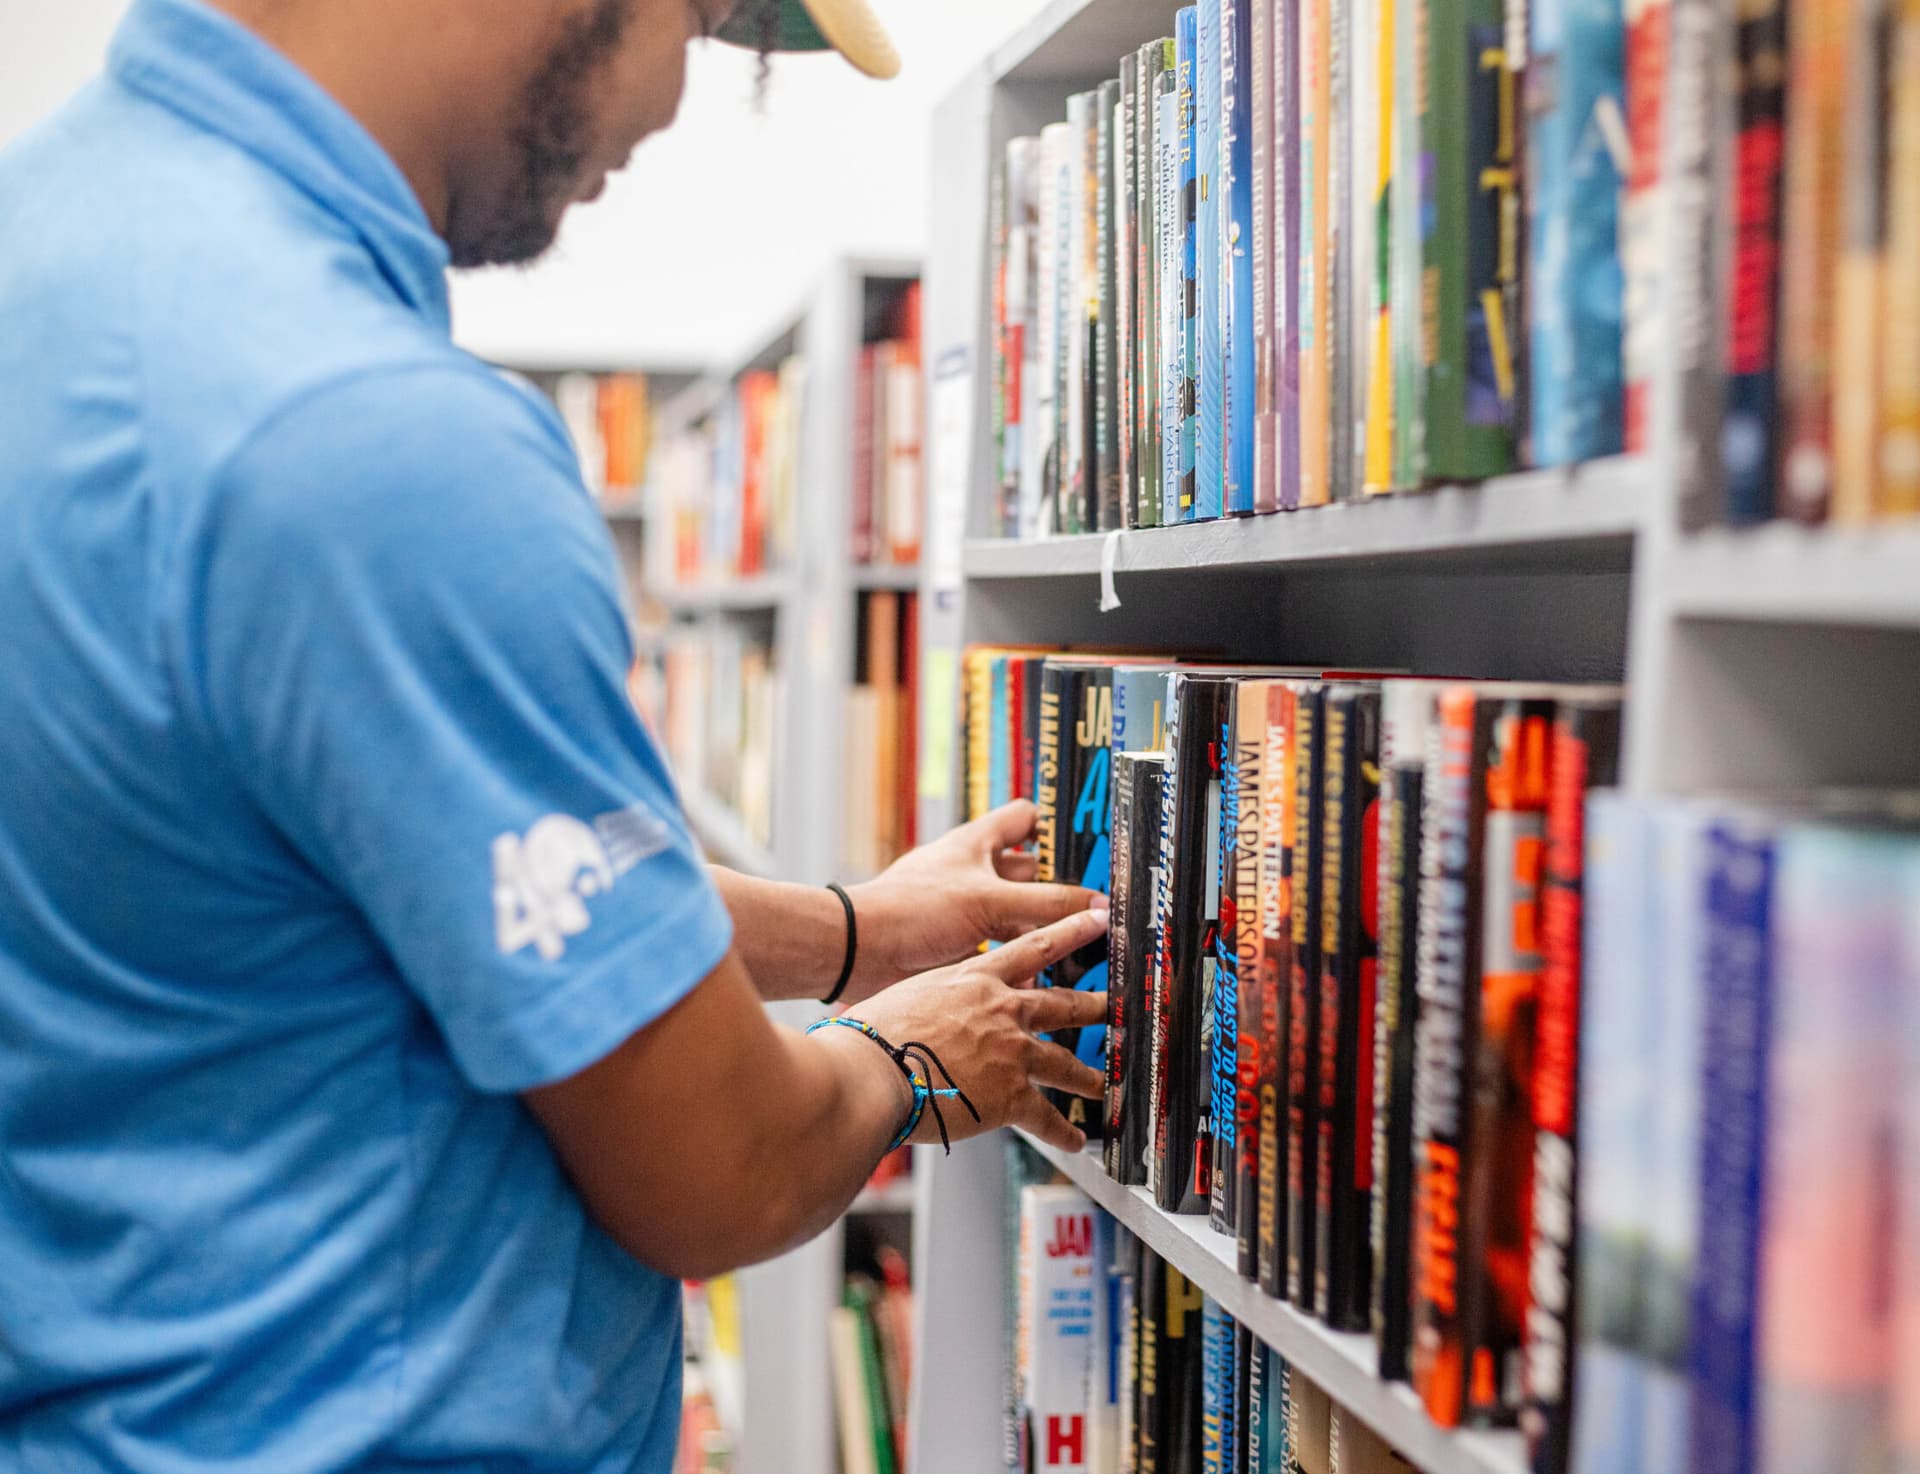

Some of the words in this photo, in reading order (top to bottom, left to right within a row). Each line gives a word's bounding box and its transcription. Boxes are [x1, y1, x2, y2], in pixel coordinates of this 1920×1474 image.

[1177, 60, 1191, 140] Robert
[1166, 363, 1175, 417] KATE
[1165, 425, 1175, 508] PARKER
[1040, 692, 1059, 779] JAMES
[1264, 724, 1286, 801] JAMES
[1218, 723, 1229, 887] PATTERSON
[1225, 761, 1239, 852] JAMES
[1239, 742, 1260, 823] JAMES
[1119, 815, 1128, 878] JAMES
[1263, 803, 1285, 939] PATTERSON
[1116, 882, 1127, 987] PATTERSON
[1237, 831, 1260, 983] PATTERSON
[1223, 971, 1238, 1043] COAST
[1222, 1046, 1237, 1075] TO
[1221, 1078, 1236, 1149] COAST
[1259, 1084, 1277, 1247] COUNTRY
[1220, 1312, 1234, 1415] LONDON
[1250, 1354, 1262, 1425] JAMES
[1289, 1400, 1300, 1467] JAMES
